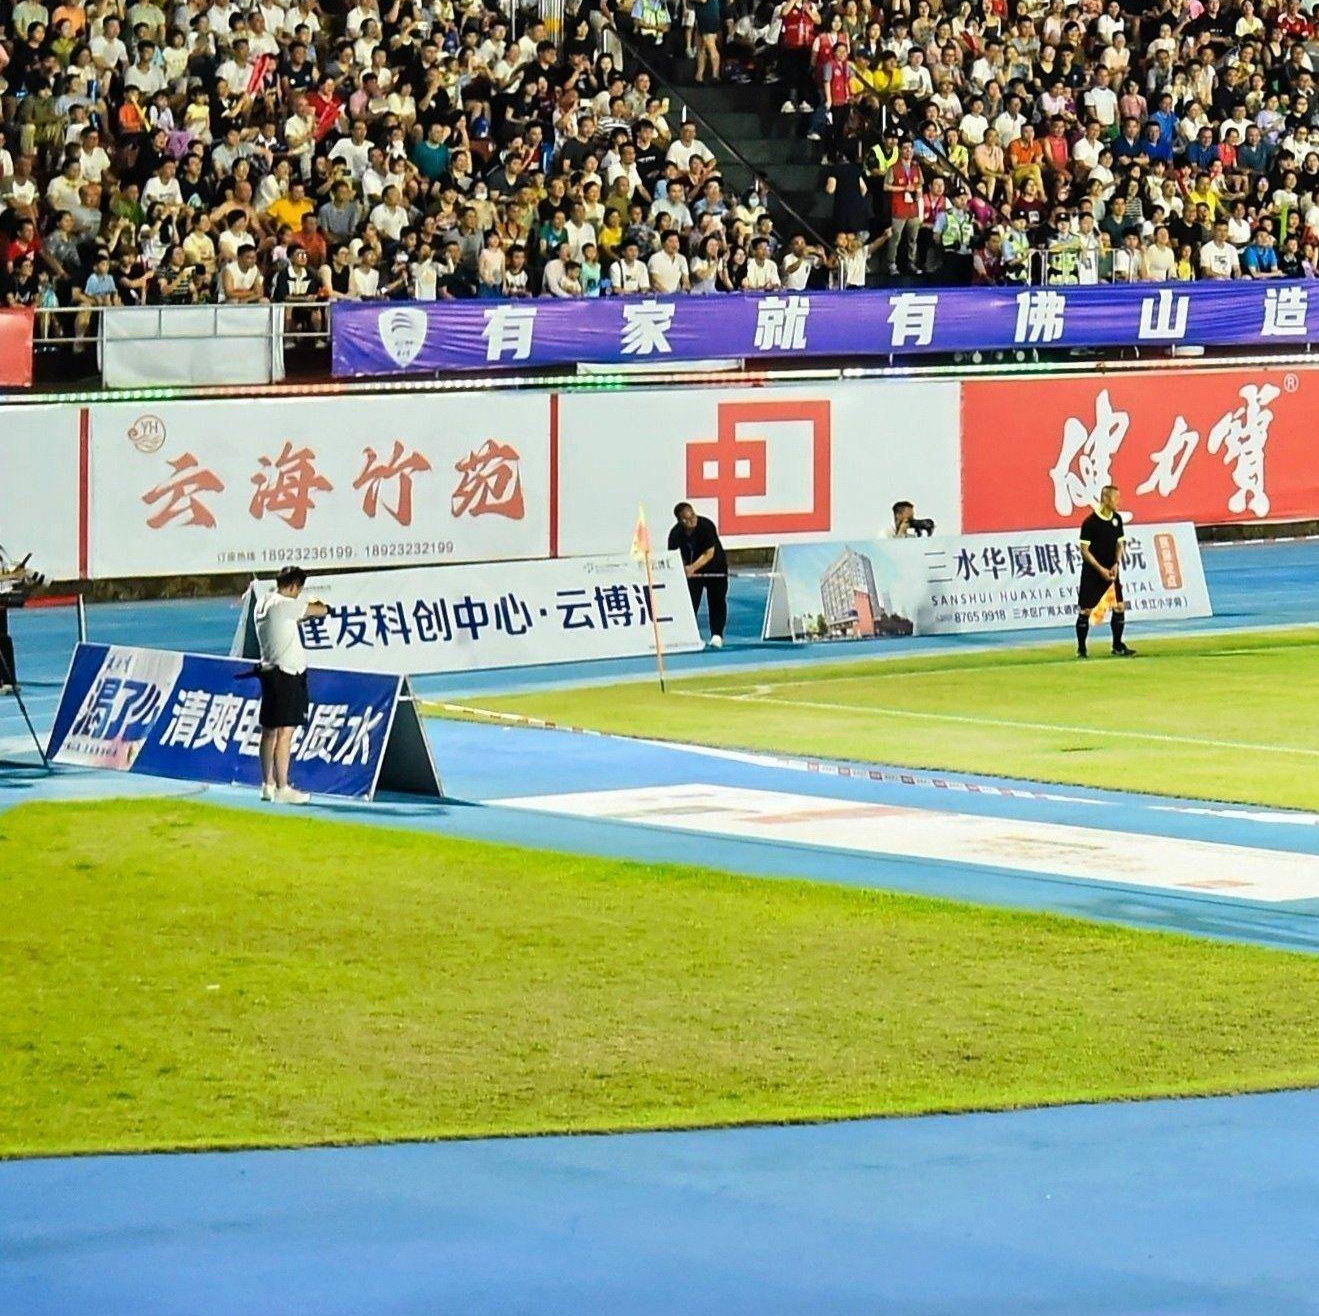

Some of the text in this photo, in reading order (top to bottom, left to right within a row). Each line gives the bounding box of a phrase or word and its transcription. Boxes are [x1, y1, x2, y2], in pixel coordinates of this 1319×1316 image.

[482, 286, 1308, 362] 有家就有佛山造
[141, 439, 525, 530] 云海竹苑
[365, 541, 454, 557] 18923232199
[925, 538, 1147, 583] 三水华厦眼科院
[931, 592, 993, 607] SANSHUI
[1000, 588, 1052, 603] HUAXIA
[159, 689, 386, 767] 清爽电质水
